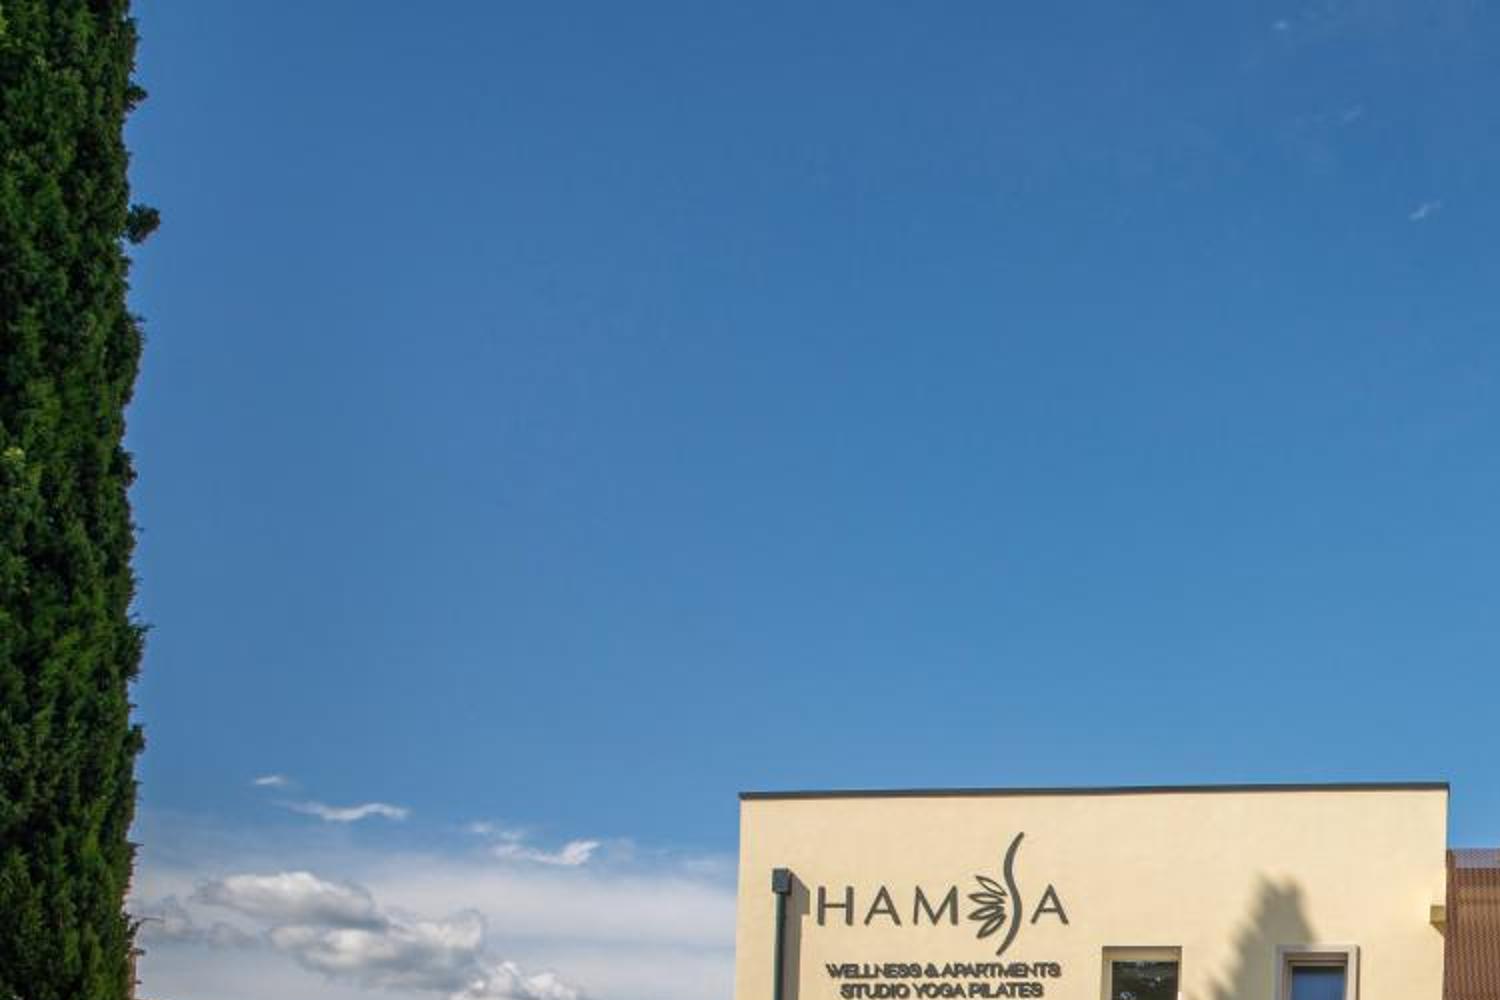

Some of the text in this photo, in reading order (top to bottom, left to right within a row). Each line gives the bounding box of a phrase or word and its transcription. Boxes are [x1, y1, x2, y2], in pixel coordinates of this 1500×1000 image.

[817, 832, 1069, 956] HAMSA
[826, 962, 1061, 979] WELLNESS & APARTMENTS
[841, 982, 1044, 999] STUDIO YOGA PILATES
